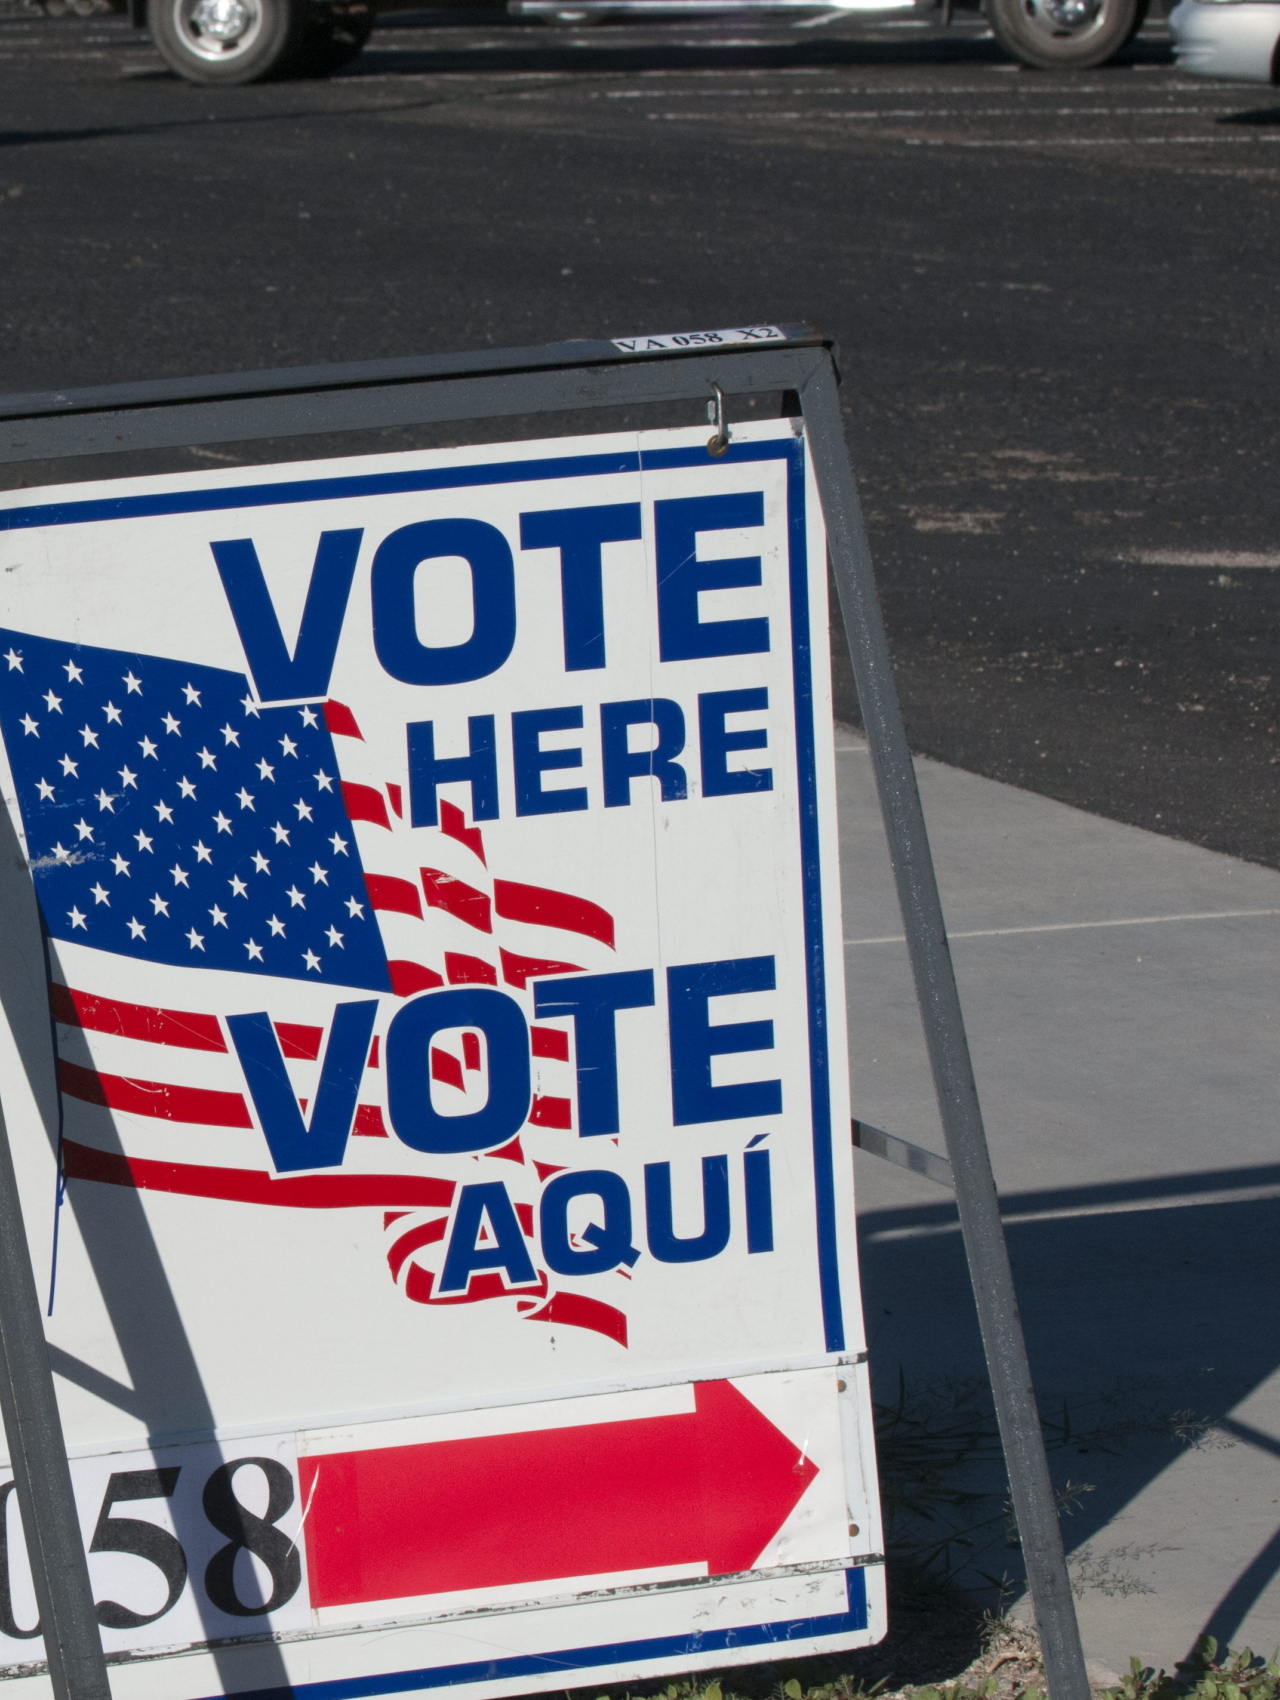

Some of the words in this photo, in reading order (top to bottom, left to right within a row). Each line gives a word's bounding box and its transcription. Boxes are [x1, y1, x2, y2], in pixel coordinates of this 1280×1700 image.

[672, 332, 723, 346] 058
[736, 328, 779, 341] X2
[209, 491, 771, 702] VOTE
[406, 686, 774, 829] HERE
[224, 954, 783, 1173] VOTE
[437, 1132, 775, 1293] AQUÍ
